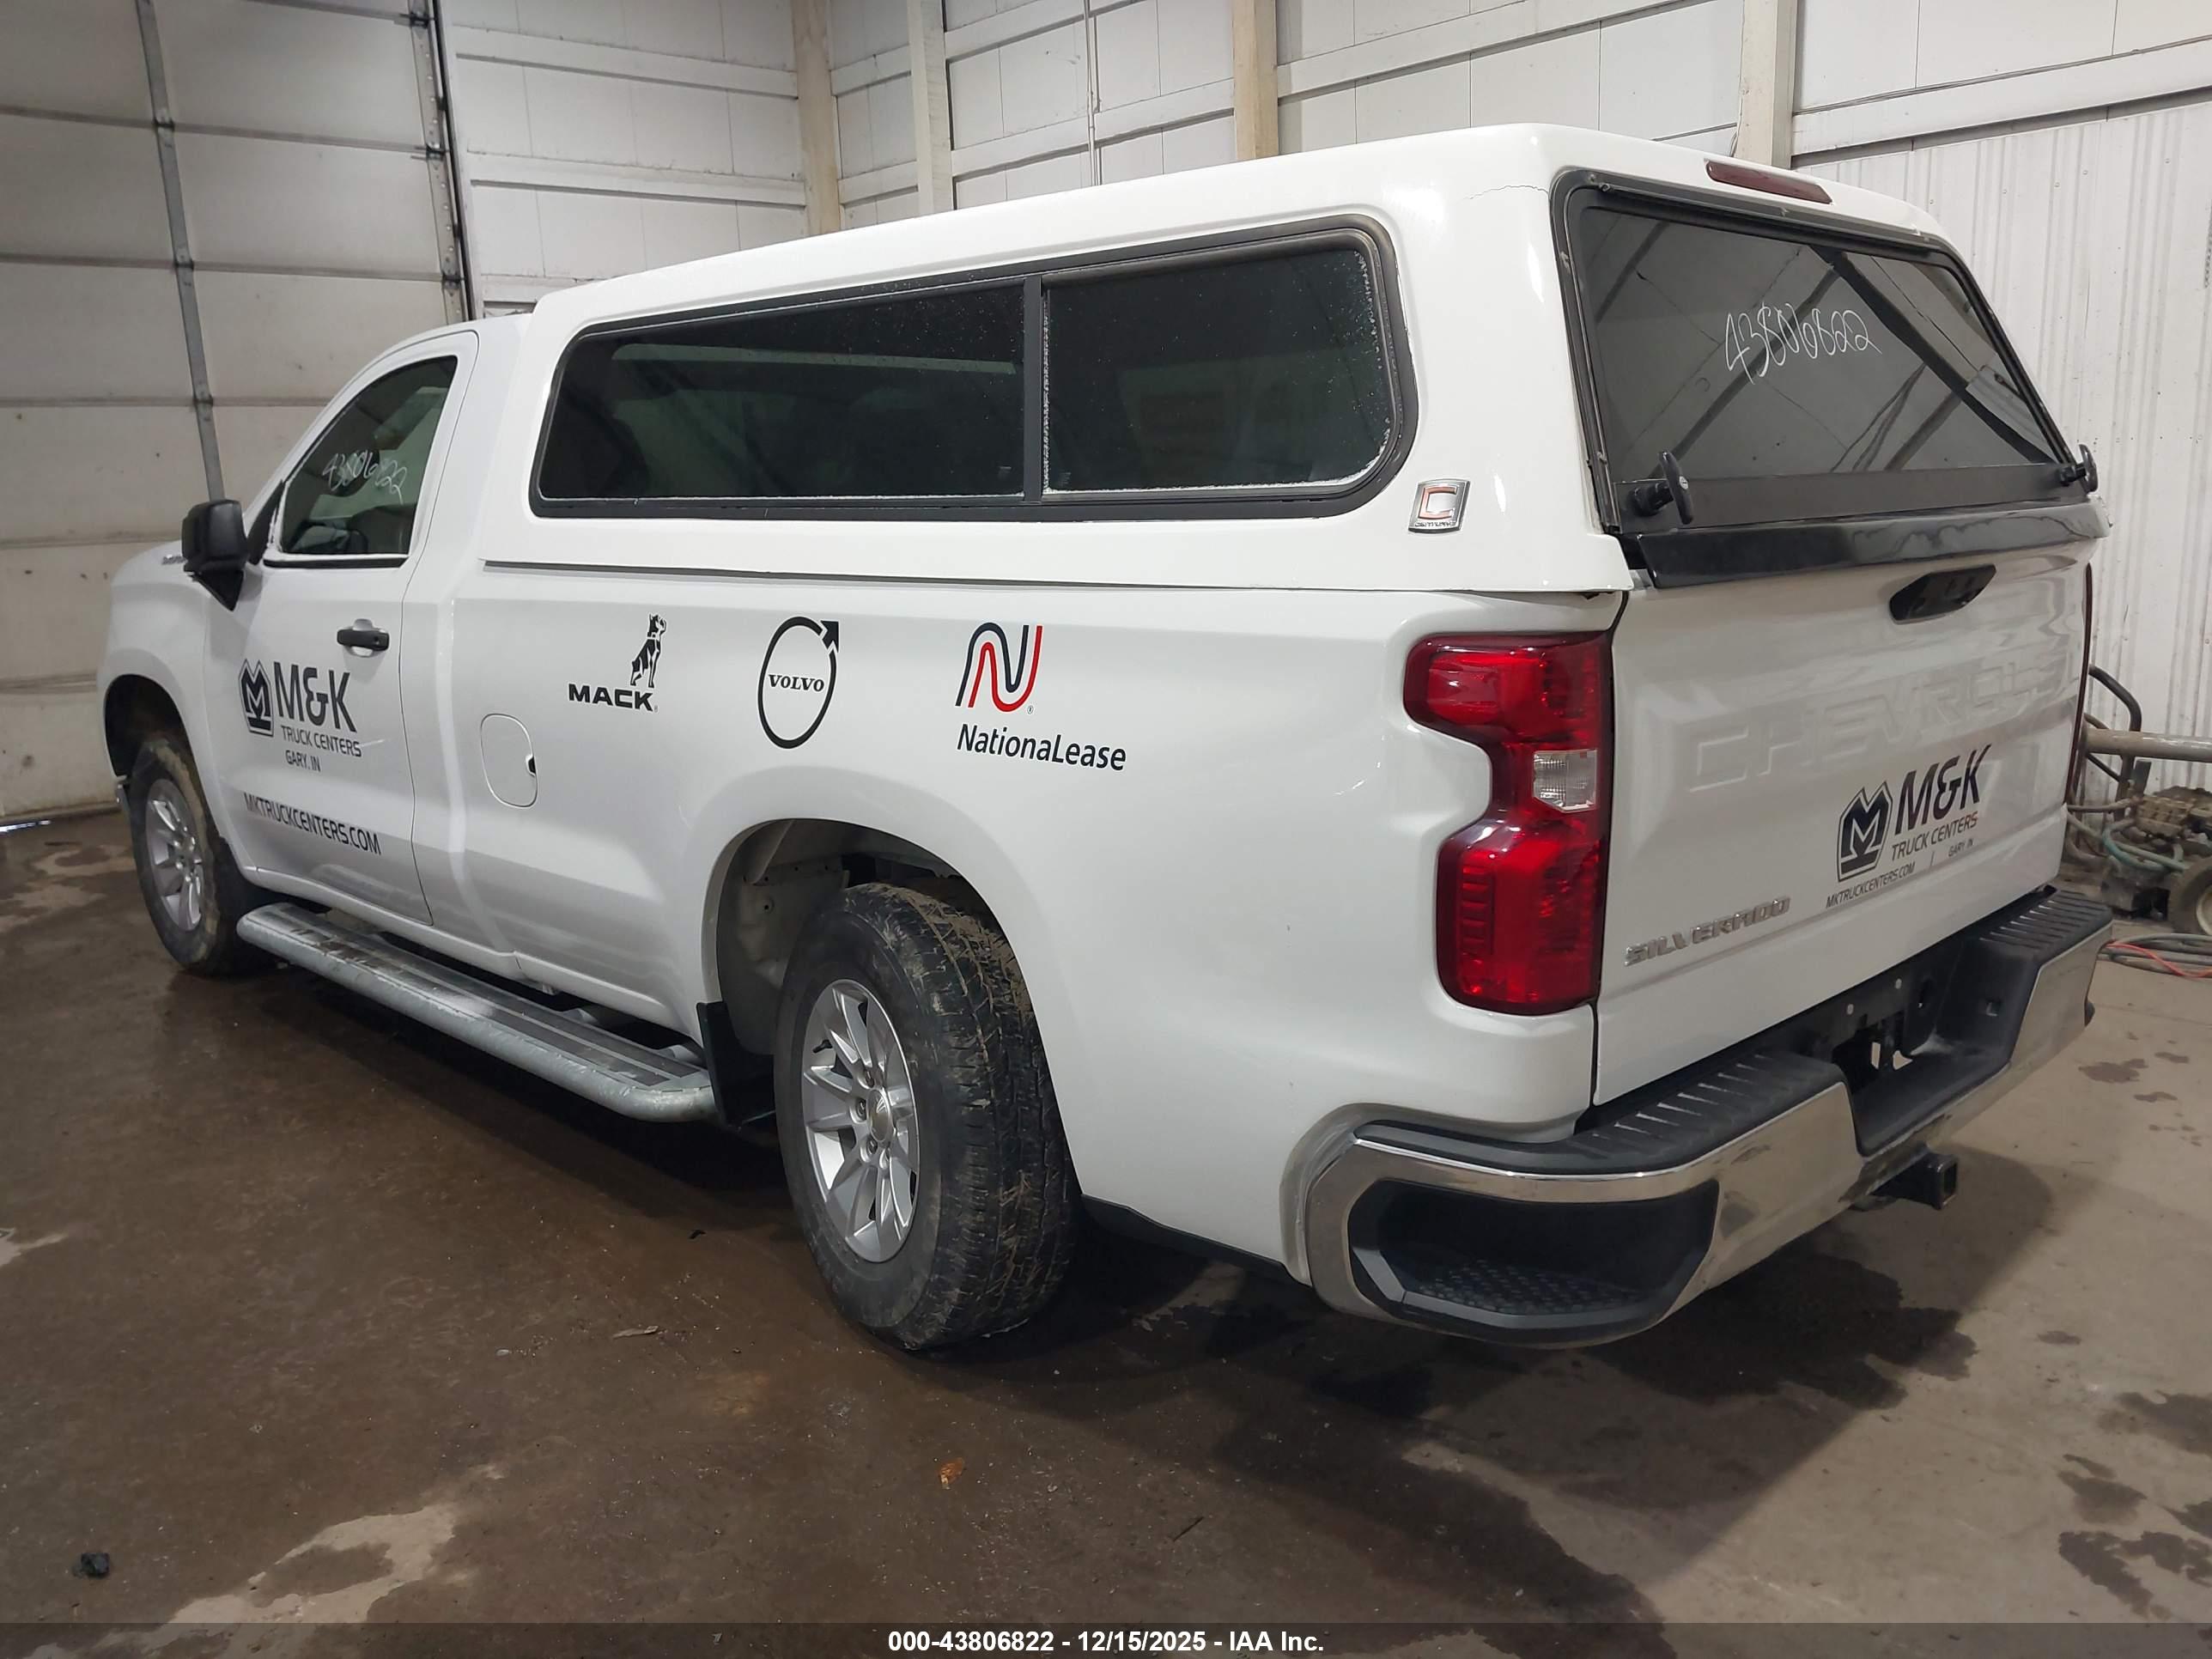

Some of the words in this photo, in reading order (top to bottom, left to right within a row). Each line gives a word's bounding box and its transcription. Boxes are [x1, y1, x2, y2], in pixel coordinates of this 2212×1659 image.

[273, 661, 358, 733] M&K
[568, 683, 653, 712] MACK
[769, 674, 825, 692] VOLVO
[281, 725, 313, 749] TRUCK
[313, 732, 362, 757] CENTERS
[310, 755, 321, 772] IN
[957, 723, 1127, 771] NationaLease
[1894, 744, 1991, 836] M&K
[244, 792, 382, 856] MKTRUCKCENTERS.COM
[1891, 830, 1932, 861] TRUCK
[1931, 811, 1978, 845] CENTERS
[1826, 861, 1916, 908] MKTRUCKCENTERS.COM
[1625, 896, 1791, 967] SILVERADO
